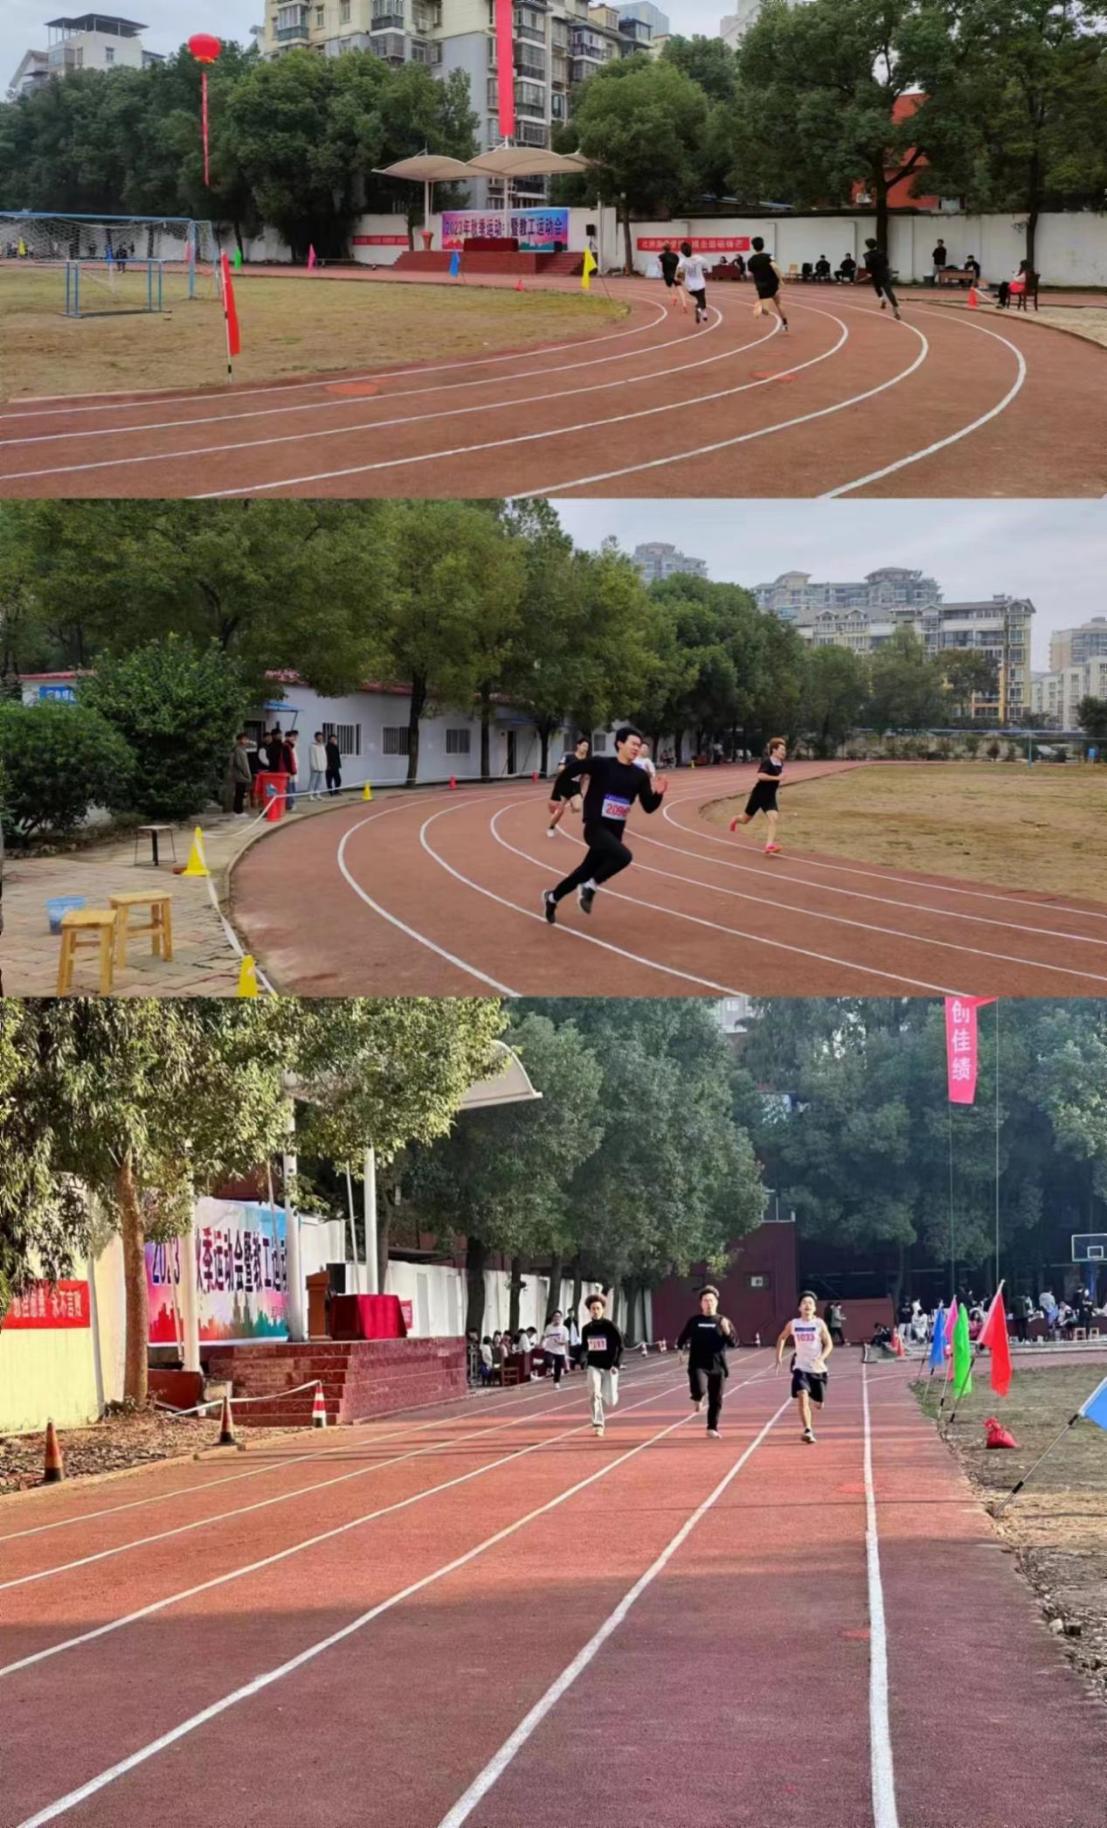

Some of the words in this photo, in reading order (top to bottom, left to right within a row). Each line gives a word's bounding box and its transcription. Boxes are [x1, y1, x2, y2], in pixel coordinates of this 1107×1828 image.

[445, 217, 563, 238] 2023年秋季运动暨教工运动会
[951, 1000, 971, 1081] 创佳绩
